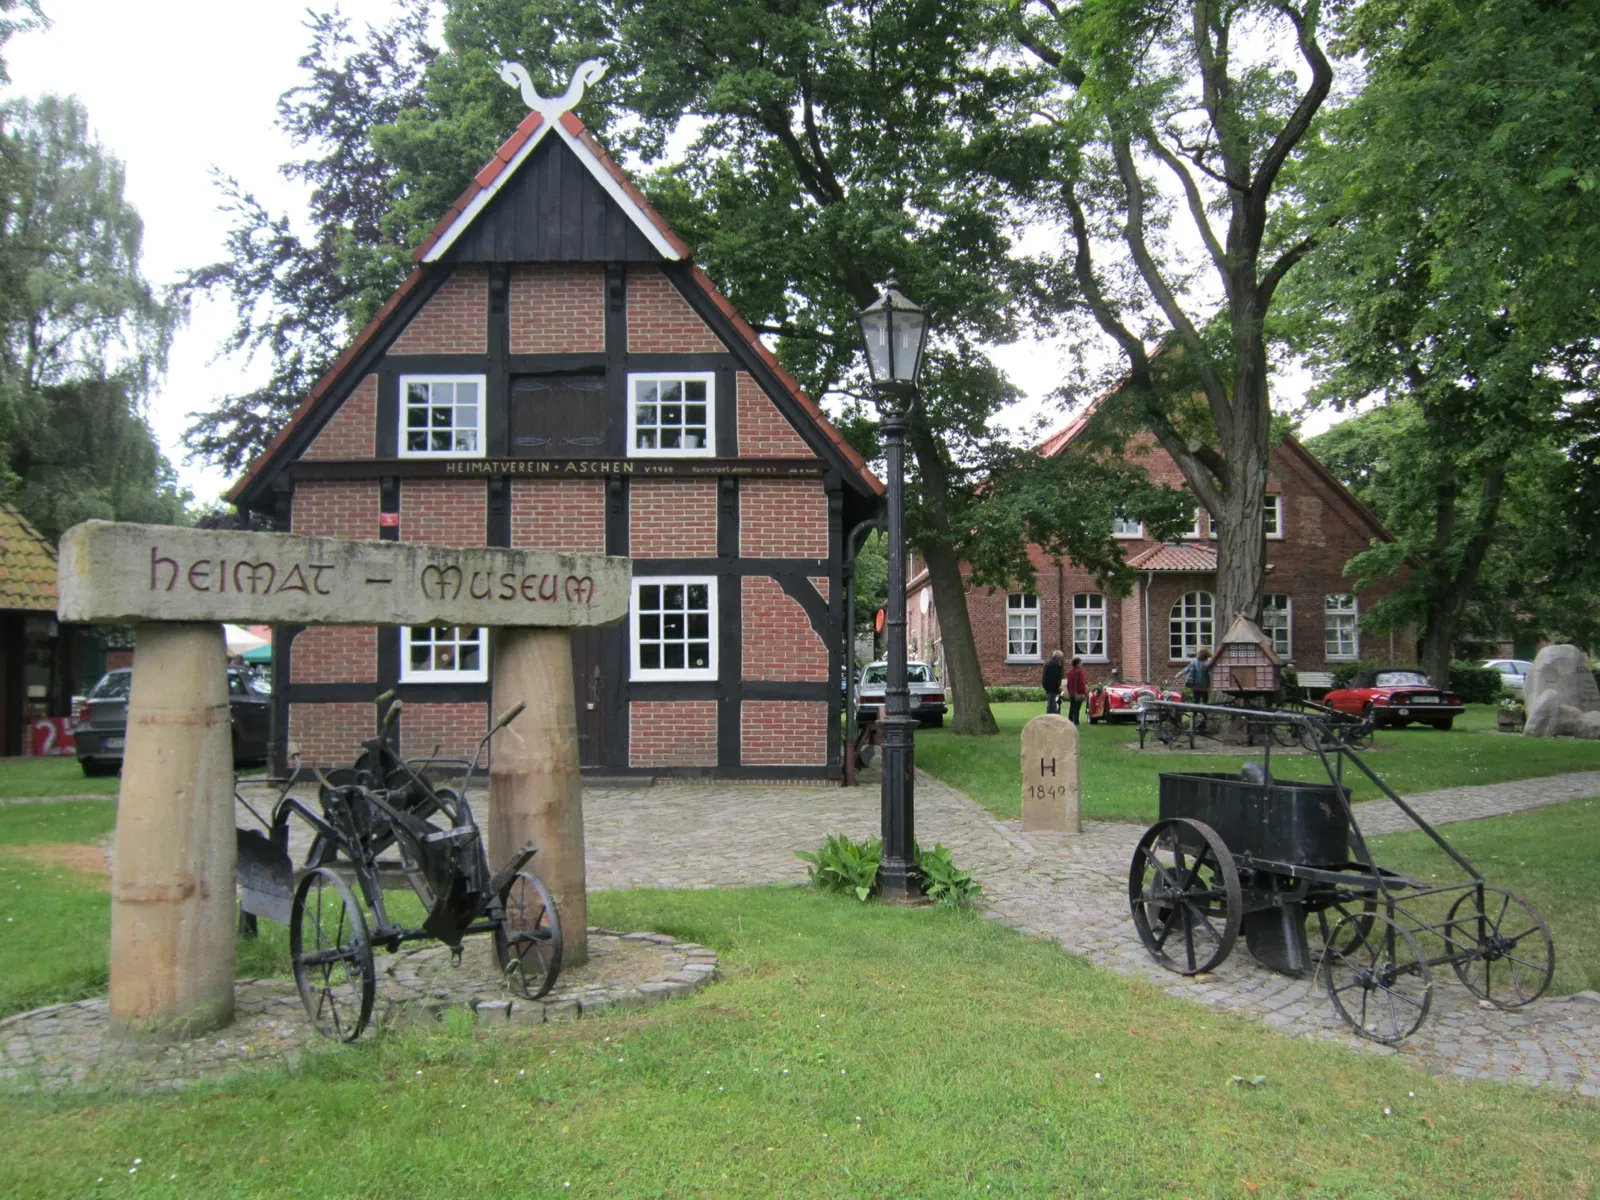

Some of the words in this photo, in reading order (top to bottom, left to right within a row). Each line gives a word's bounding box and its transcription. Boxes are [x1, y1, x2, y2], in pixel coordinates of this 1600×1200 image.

[446, 461, 550, 474] HEIMATVEREIN
[564, 461, 635, 473] ASCHEN
[1040, 757, 1056, 777] H
